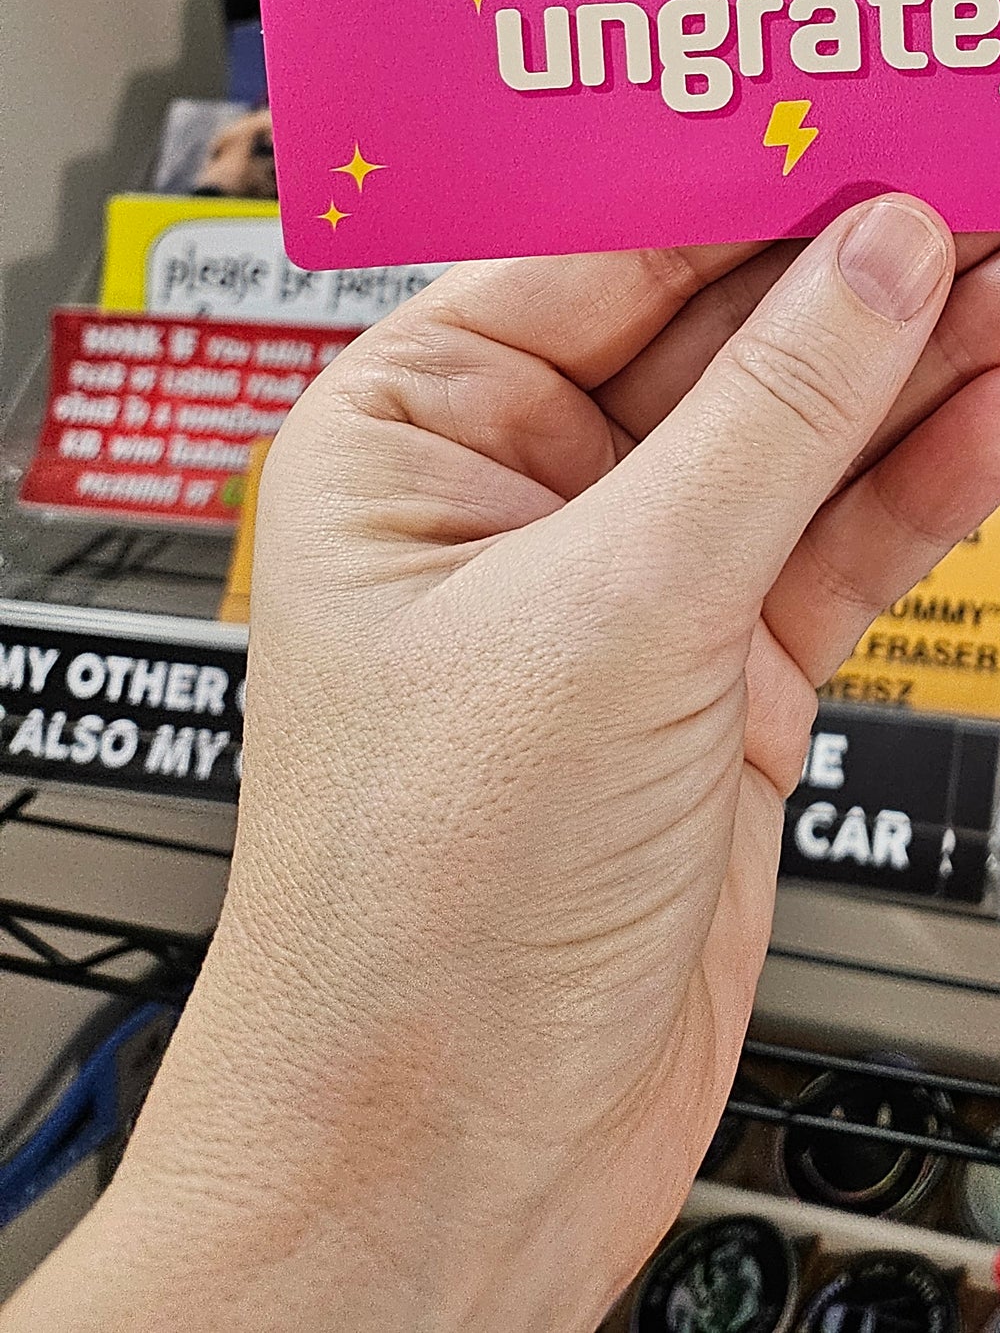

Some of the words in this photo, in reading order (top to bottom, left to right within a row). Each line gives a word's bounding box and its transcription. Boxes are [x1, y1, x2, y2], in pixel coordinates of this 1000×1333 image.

[0, 644, 61, 694] MY
[66, 651, 229, 716] OTHER
[865, 631, 999, 674] FRASER
[8, 708, 139, 768] ALSO
[146, 723, 232, 780] MY
[795, 801, 913, 870] CAR
